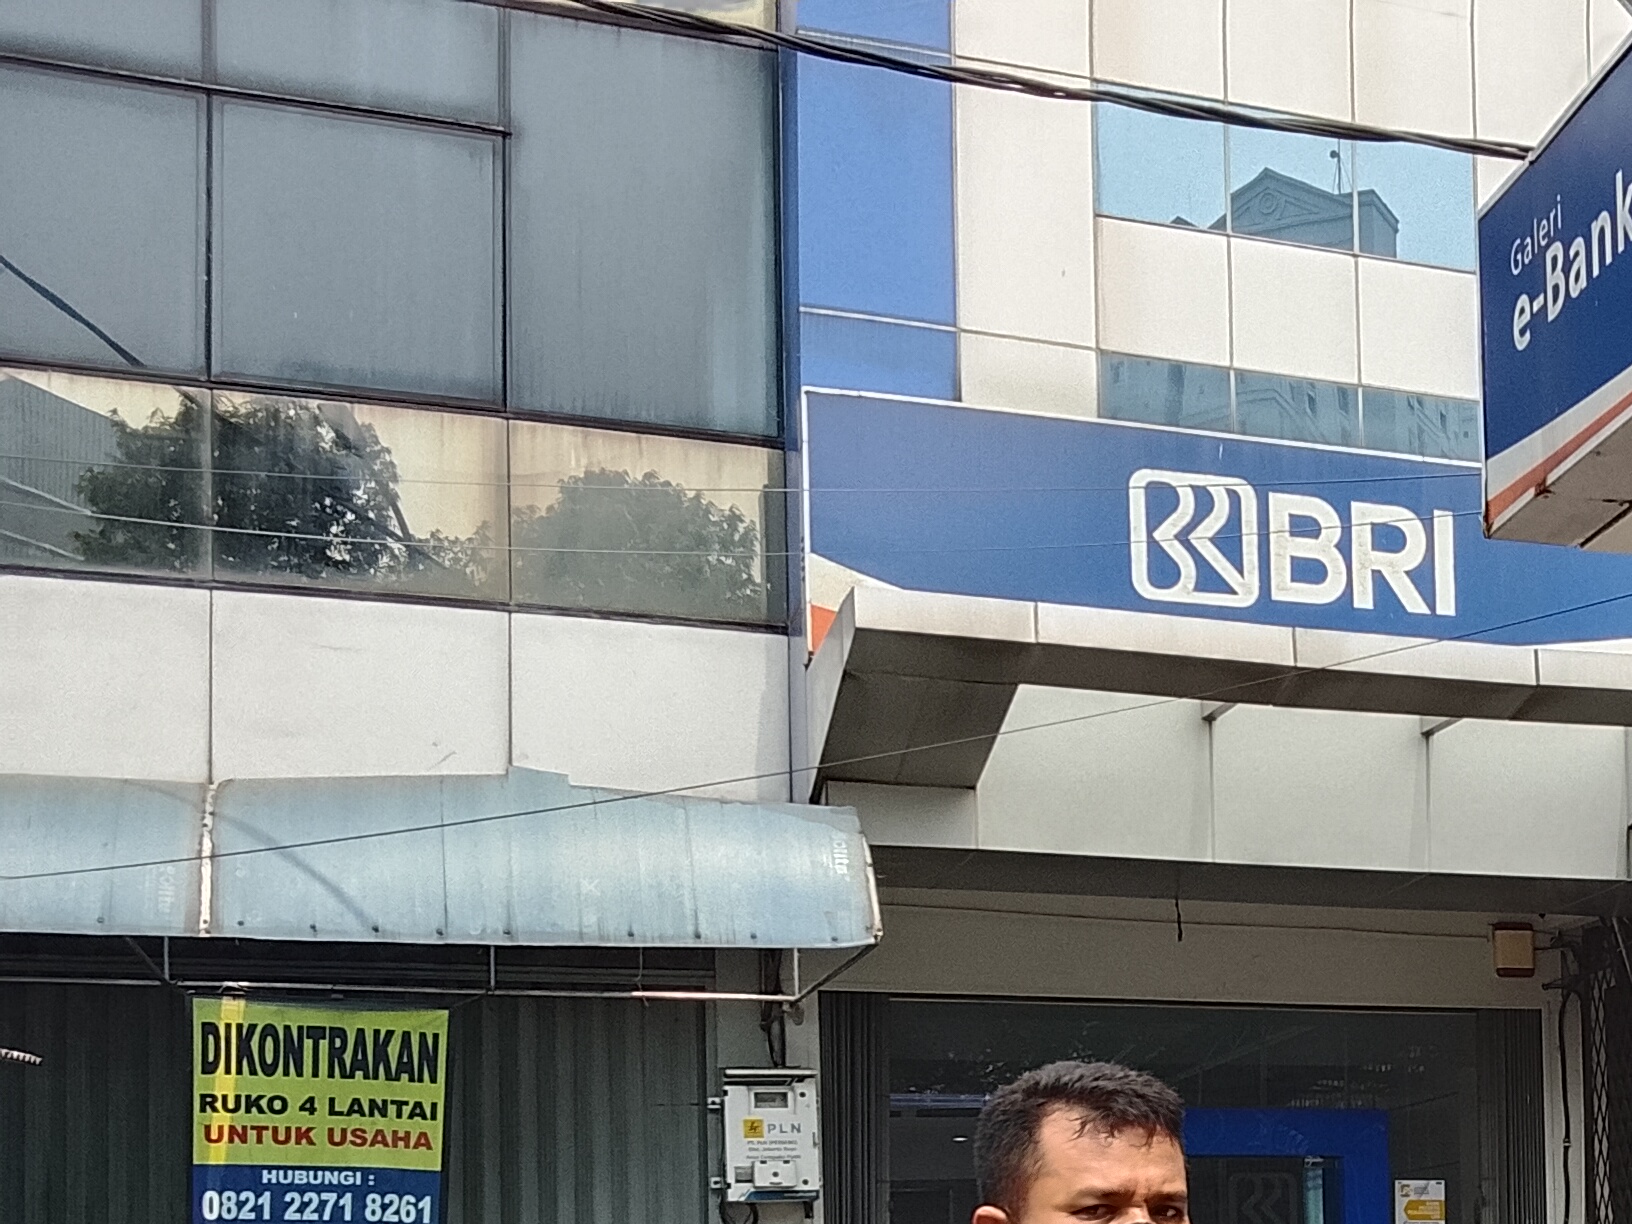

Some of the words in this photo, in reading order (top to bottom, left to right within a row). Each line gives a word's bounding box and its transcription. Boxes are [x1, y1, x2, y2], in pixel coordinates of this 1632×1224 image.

[1510, 194, 1562, 276] Galeri
[1268, 491, 1456, 617] BRI
[200, 1021, 440, 1084] DIKONTRAKAN
[199, 1093, 289, 1115] RUKO
[298, 1096, 318, 1116] 4
[328, 1097, 438, 1121] LANTAI
[204, 1124, 317, 1146] UNTUK
[327, 1127, 434, 1151] USAHA
[767, 1123, 802, 1134] PLN
[262, 1169, 362, 1186] HUBUNGI
[202, 1190, 272, 1220] 0821
[283, 1191, 353, 1222] 2271
[364, 1193, 432, 1224] 8261
